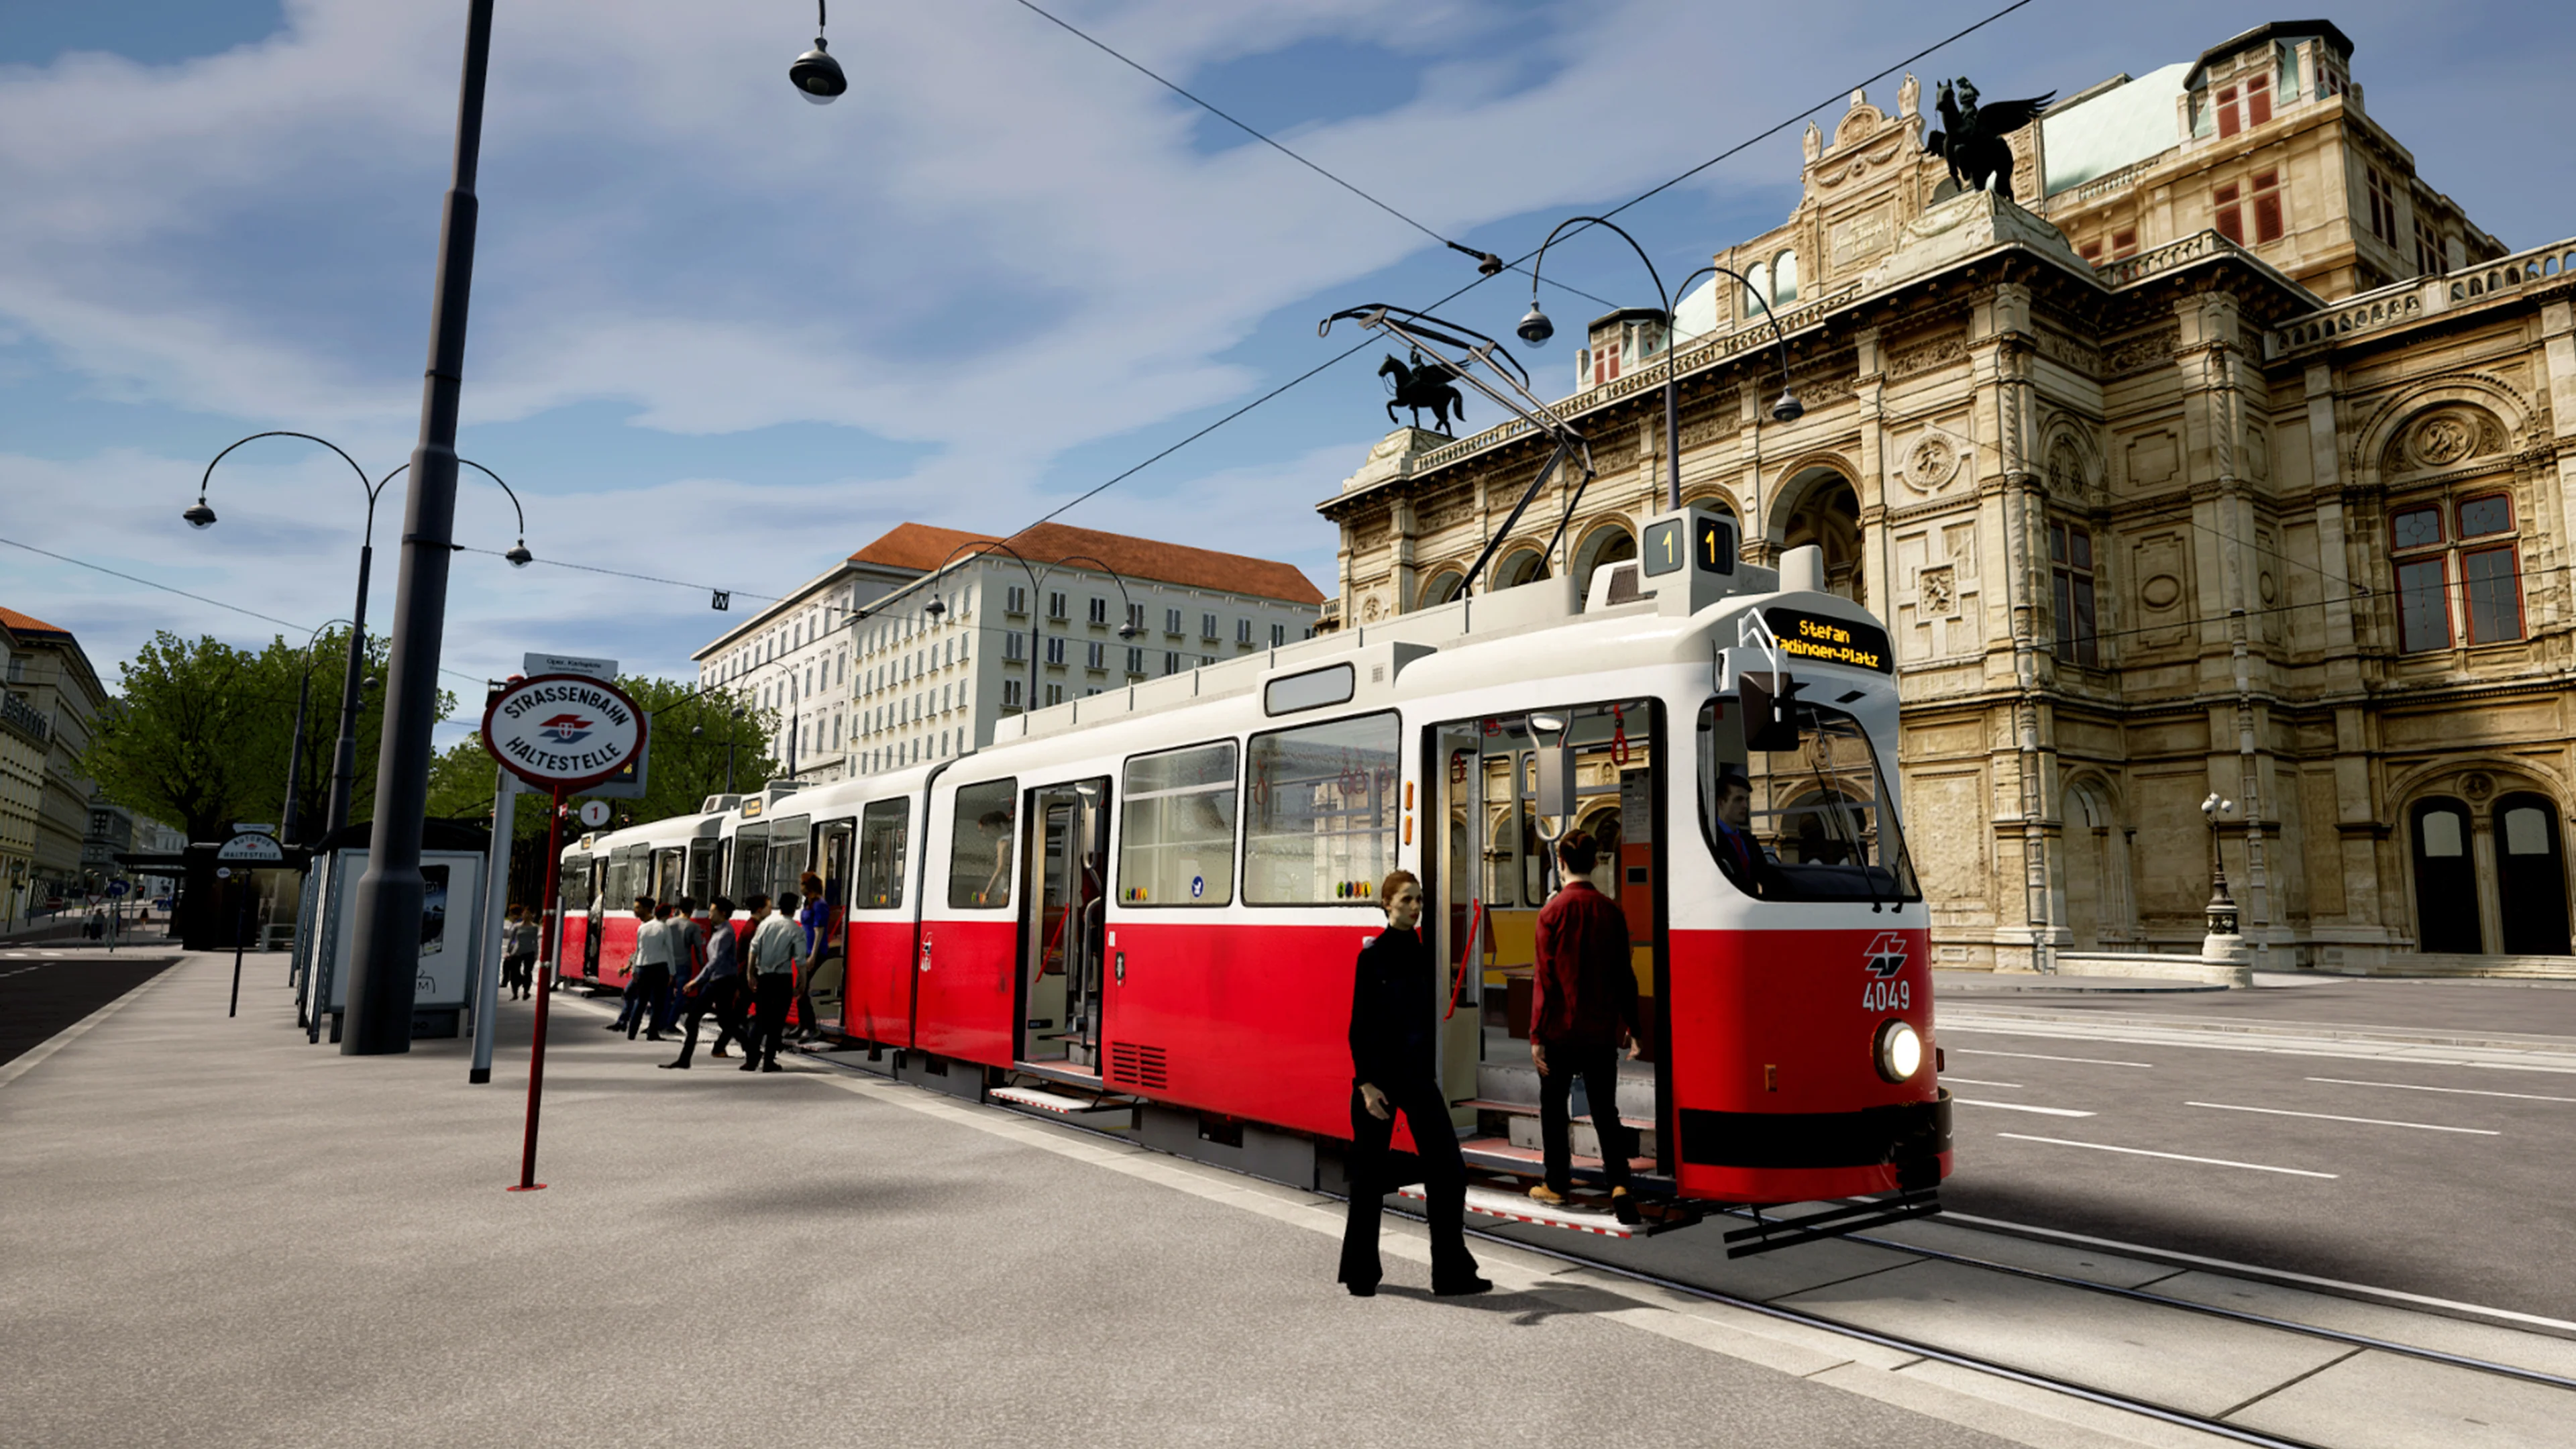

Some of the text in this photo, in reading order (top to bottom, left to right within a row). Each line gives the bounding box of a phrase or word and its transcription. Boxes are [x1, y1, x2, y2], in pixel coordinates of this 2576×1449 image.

[1662, 529, 1672, 564] 1
[1705, 529, 1715, 564] 1
[1799, 619, 1850, 644] Stefan
[504, 686, 630, 727] STRASSENBAHN
[505, 736, 621, 771] HALTESTELLE
[591, 806, 598, 820] 1
[223, 851, 277, 859] HALTESTELLE
[1862, 979, 1910, 1012] 4049
